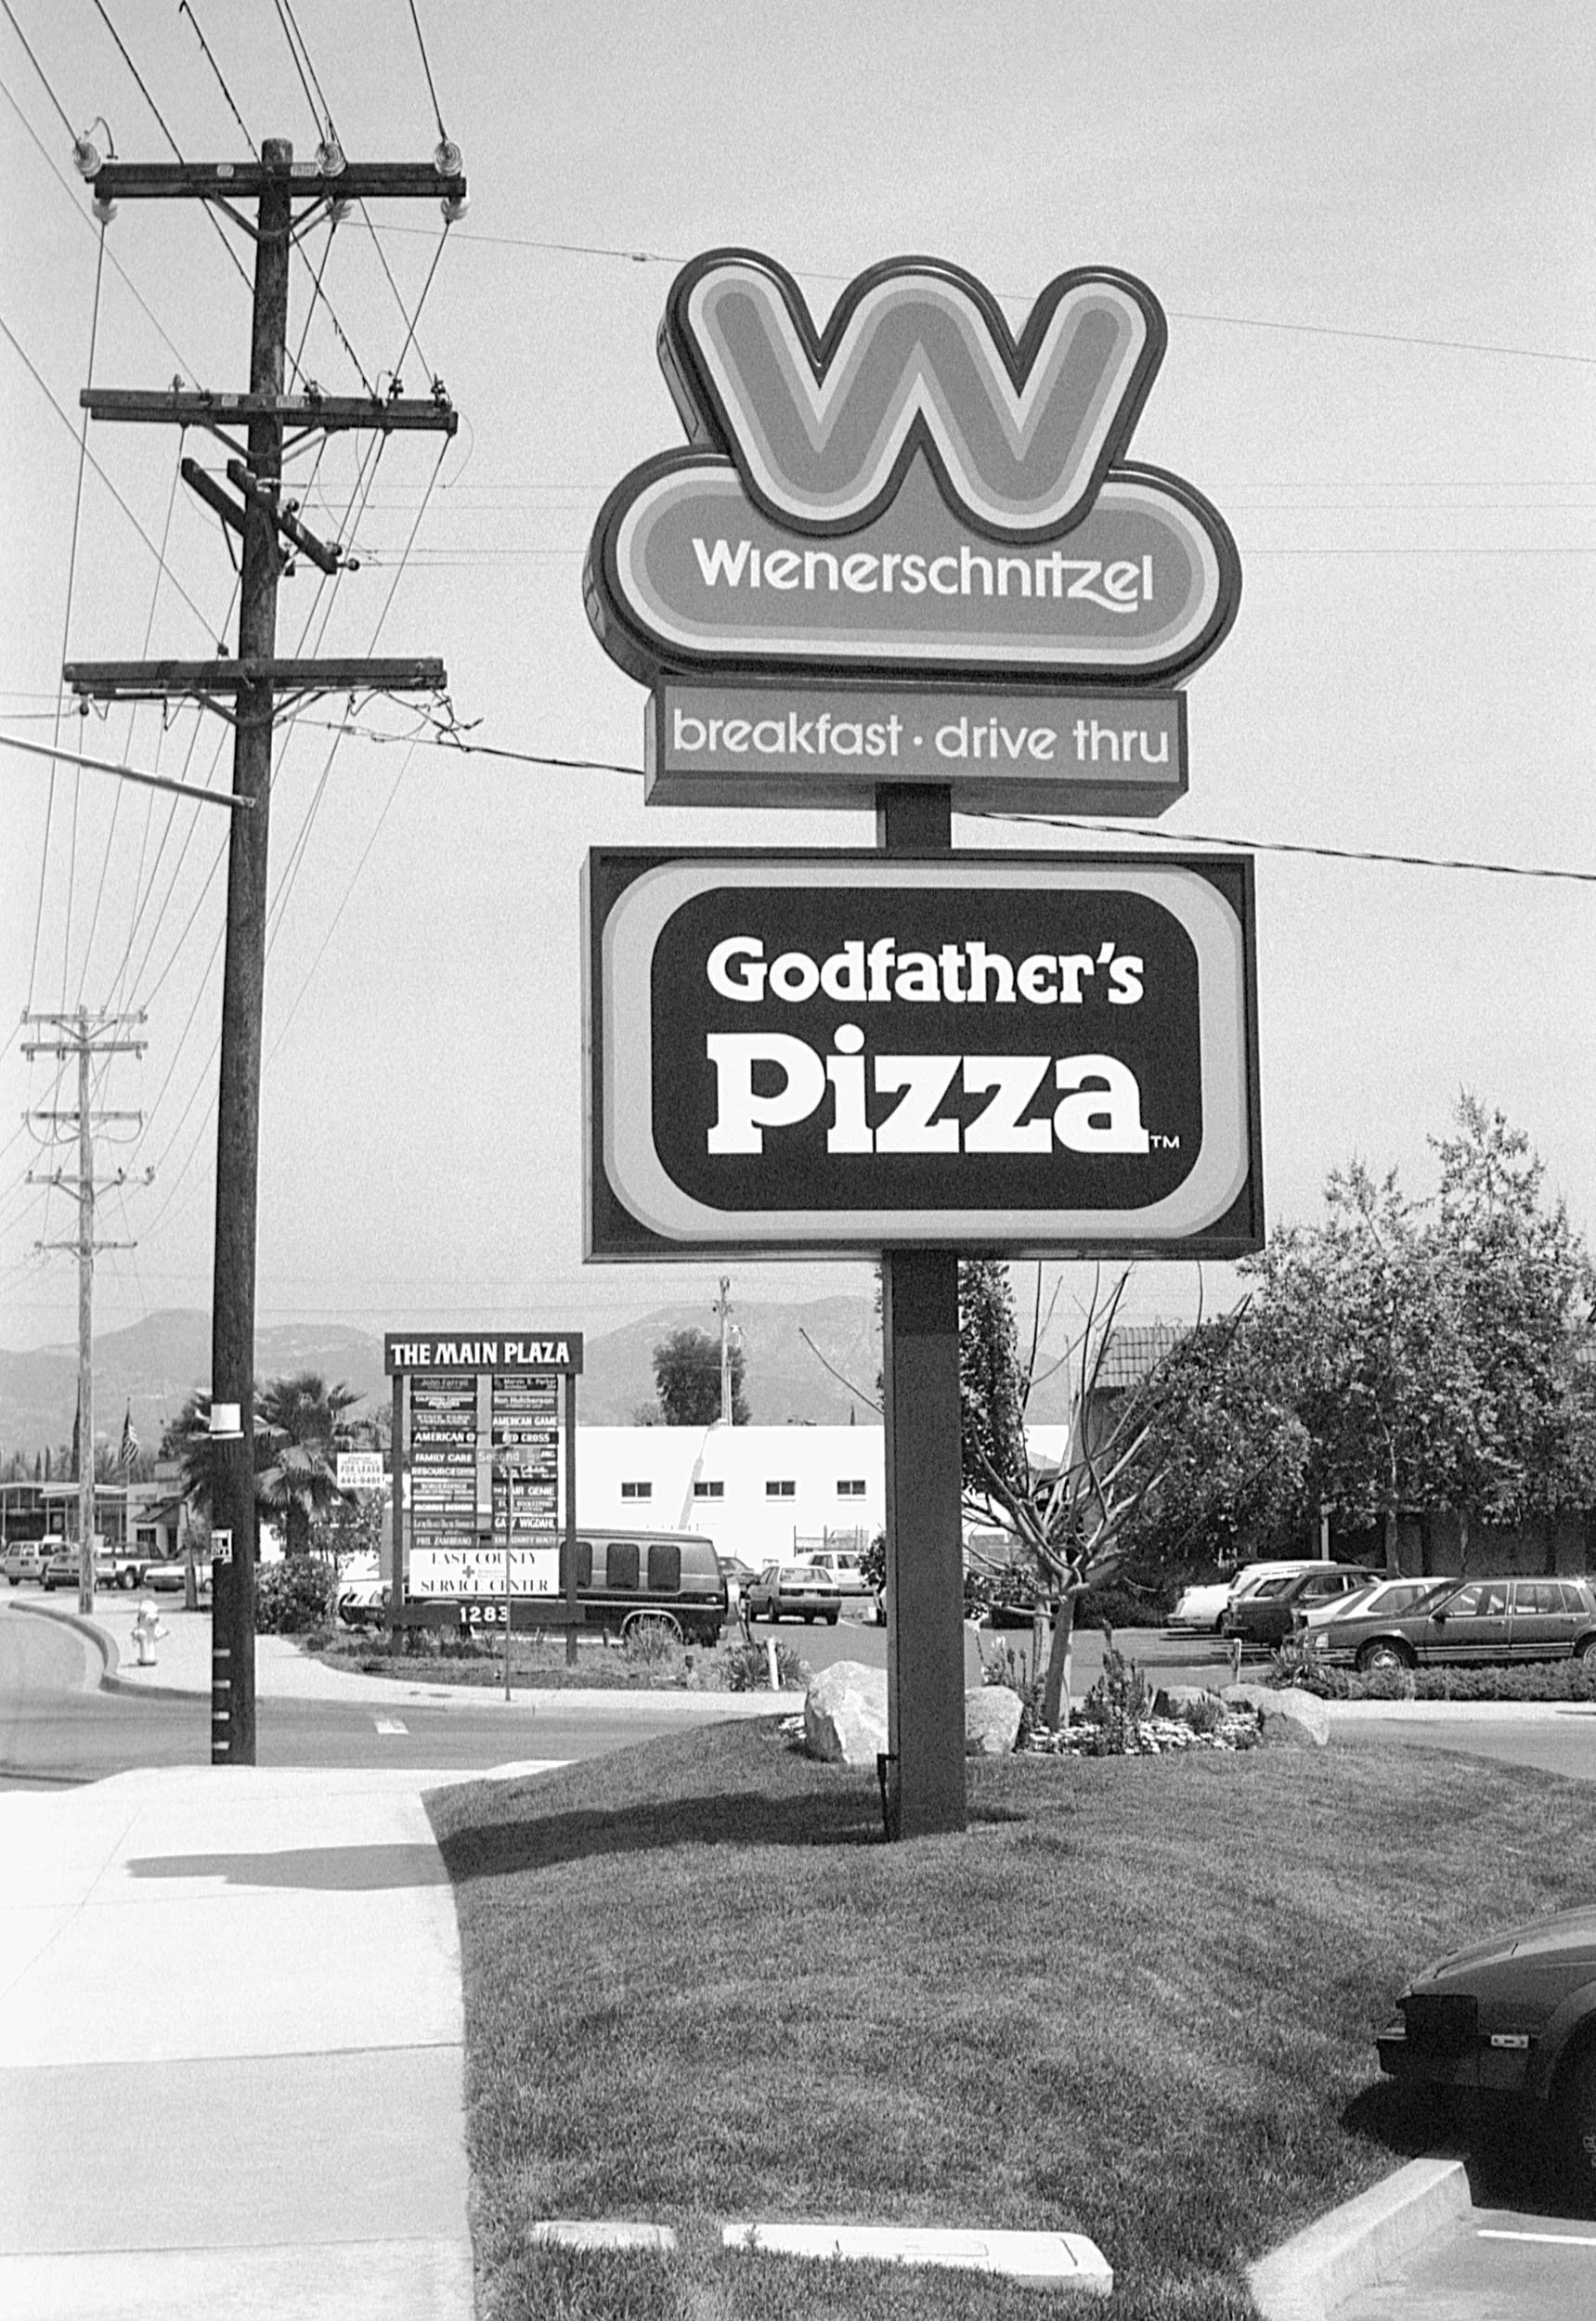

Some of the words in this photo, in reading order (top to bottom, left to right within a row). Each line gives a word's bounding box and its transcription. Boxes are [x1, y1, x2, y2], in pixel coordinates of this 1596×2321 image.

[674, 253, 1161, 542] W
[692, 538, 1153, 613] Wienerschnitzel
[673, 708, 903, 757] breakfast
[934, 717, 1055, 760] drive
[1072, 720, 1171, 763] thru
[706, 936, 1145, 1005] Godfather's
[706, 1023, 1150, 1155] Pizza
[1150, 1135, 1181, 1149] TM
[390, 1342, 431, 1366] THE
[434, 1342, 499, 1365] MAIN
[504, 1342, 570, 1364] PLAZA
[492, 1416, 533, 1426] AMERICAN
[534, 1416, 558, 1426] GAME
[414, 1433, 464, 1442] AMERICAN
[520, 1433, 551, 1443] CROSS
[415, 1453, 446, 1463] FAMILY
[448, 1453, 473, 1463] CARE
[478, 1450, 520, 1462] Second
[411, 1467, 456, 1476] RESOURCE
[494, 1517, 517, 1529] GAY
[431, 1551, 468, 1565] EAST
[474, 1551, 537, 1565] COUNTY
[421, 1579, 484, 1592] SERVICE
[489, 1579, 549, 1592] CENTER
[460, 1606, 508, 1623] 1283
